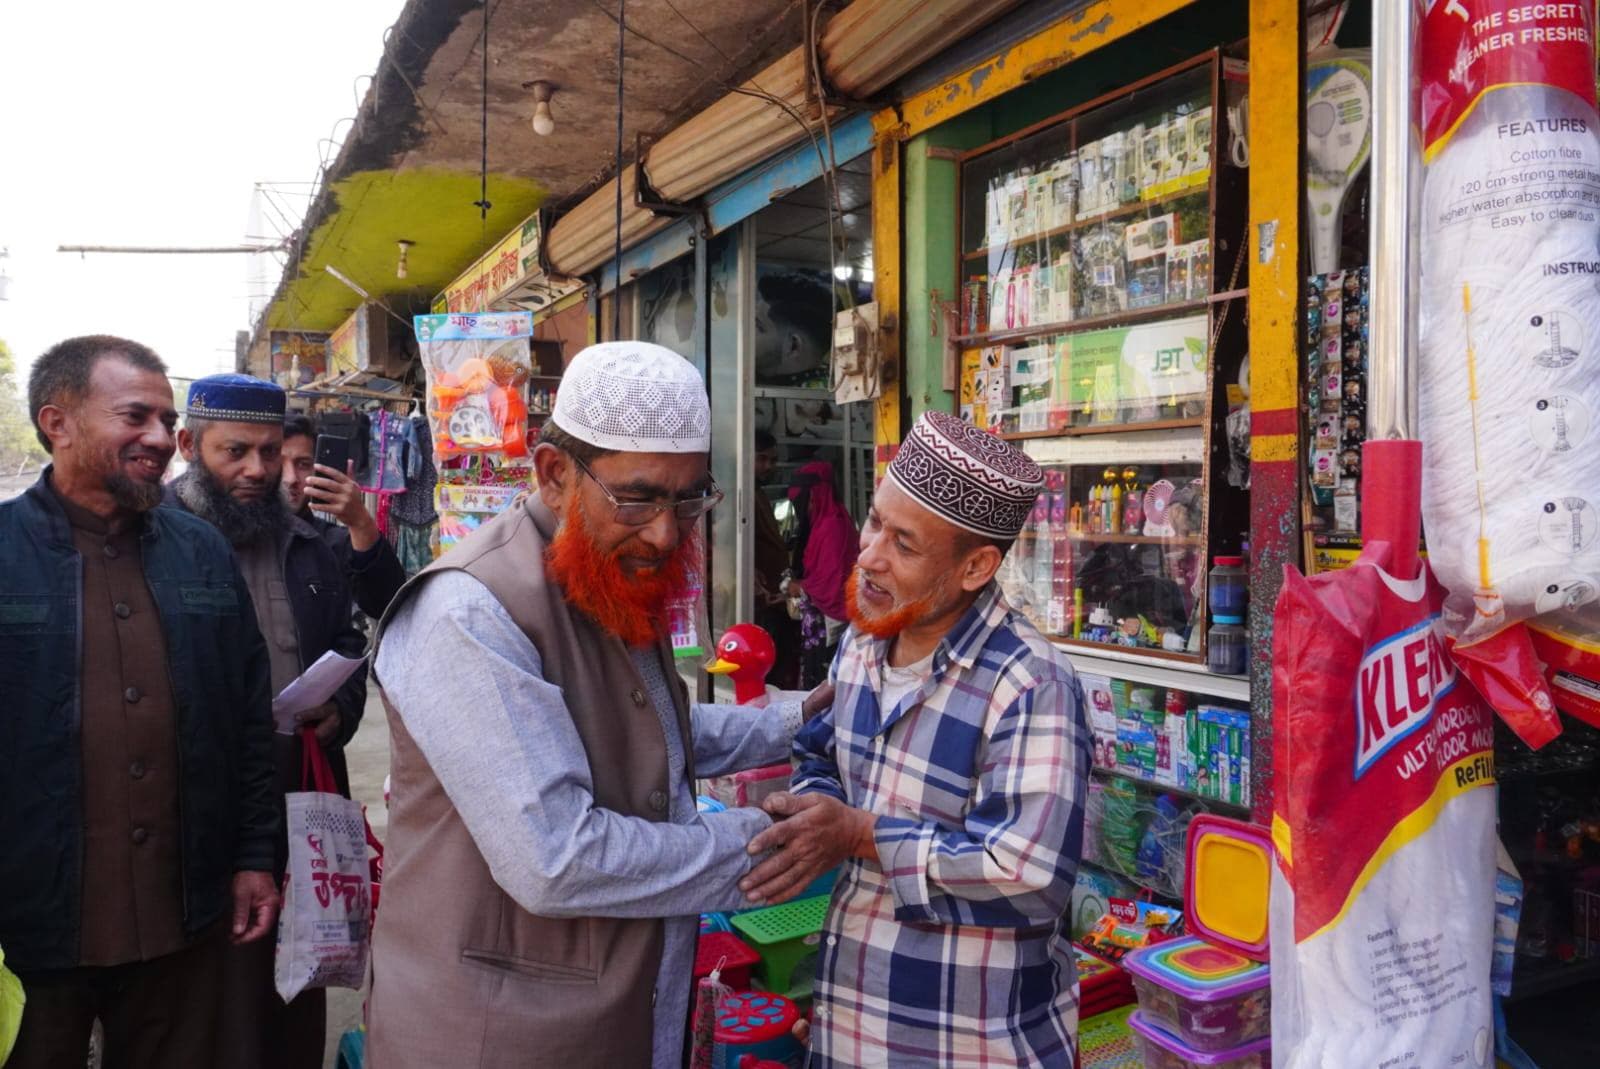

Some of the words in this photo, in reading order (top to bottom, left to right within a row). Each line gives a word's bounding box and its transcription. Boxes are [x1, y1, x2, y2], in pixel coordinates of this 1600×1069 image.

[1472, 12, 1503, 36] THE
[1508, 4, 1576, 24] SECRET
[1498, 118, 1587, 139] FEATURES
[1510, 148, 1556, 164] Cotton
[1559, 147, 1582, 160] fibre
[1486, 175, 1506, 189] cm
[1511, 168, 1555, 185] strong
[1558, 168, 1586, 180] metal
[1472, 197, 1510, 213] water
[1514, 186, 1580, 204] absorption
[1491, 213, 1526, 230] Easy
[1530, 210, 1545, 222] to
